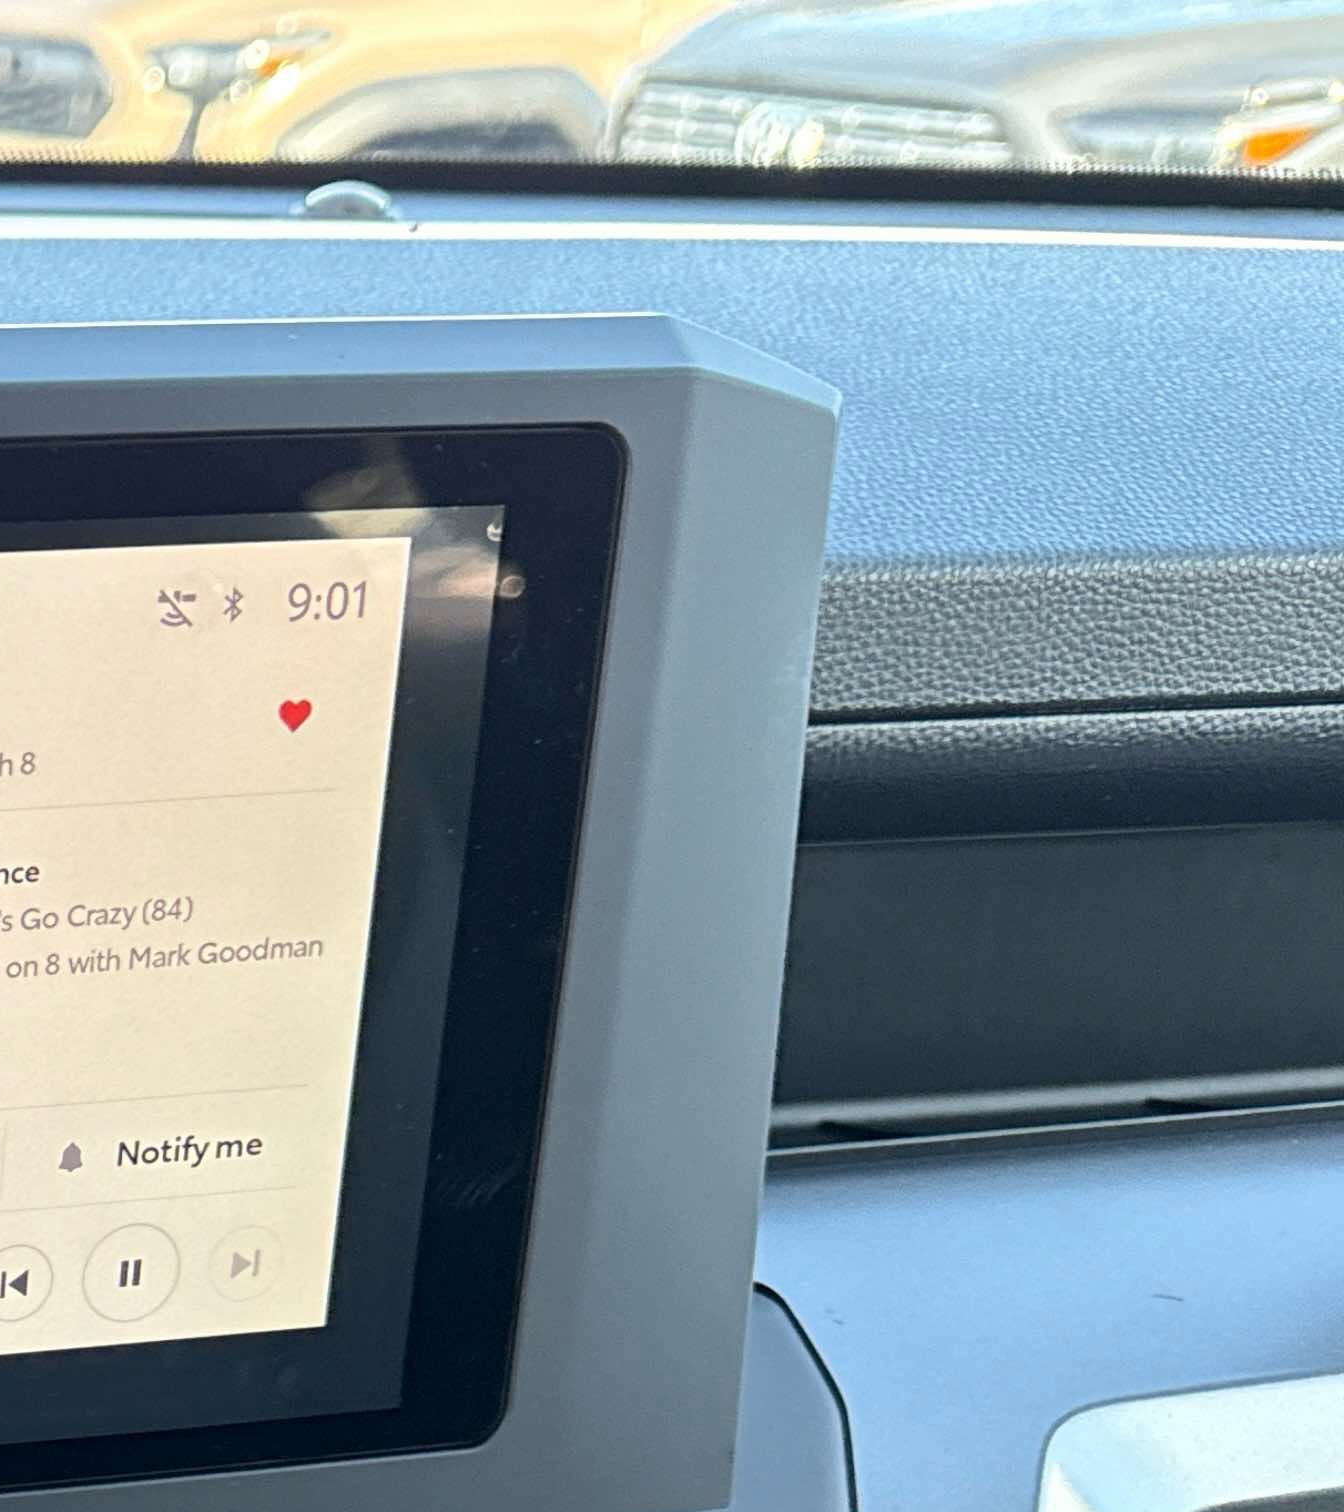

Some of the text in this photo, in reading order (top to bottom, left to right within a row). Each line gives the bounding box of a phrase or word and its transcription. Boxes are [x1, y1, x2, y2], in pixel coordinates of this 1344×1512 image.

[288, 581, 369, 623] 9:01
[20, 752, 36, 776] 8
[23, 905, 60, 932] Go
[67, 901, 137, 934] Crazy
[142, 896, 194, 927] (84)
[6, 957, 41, 978] on
[45, 951, 61, 975] 8
[68, 946, 121, 974] with
[128, 942, 191, 969] Mark
[197, 935, 324, 966] Goodman
[117, 1134, 263, 1169] Notify me
